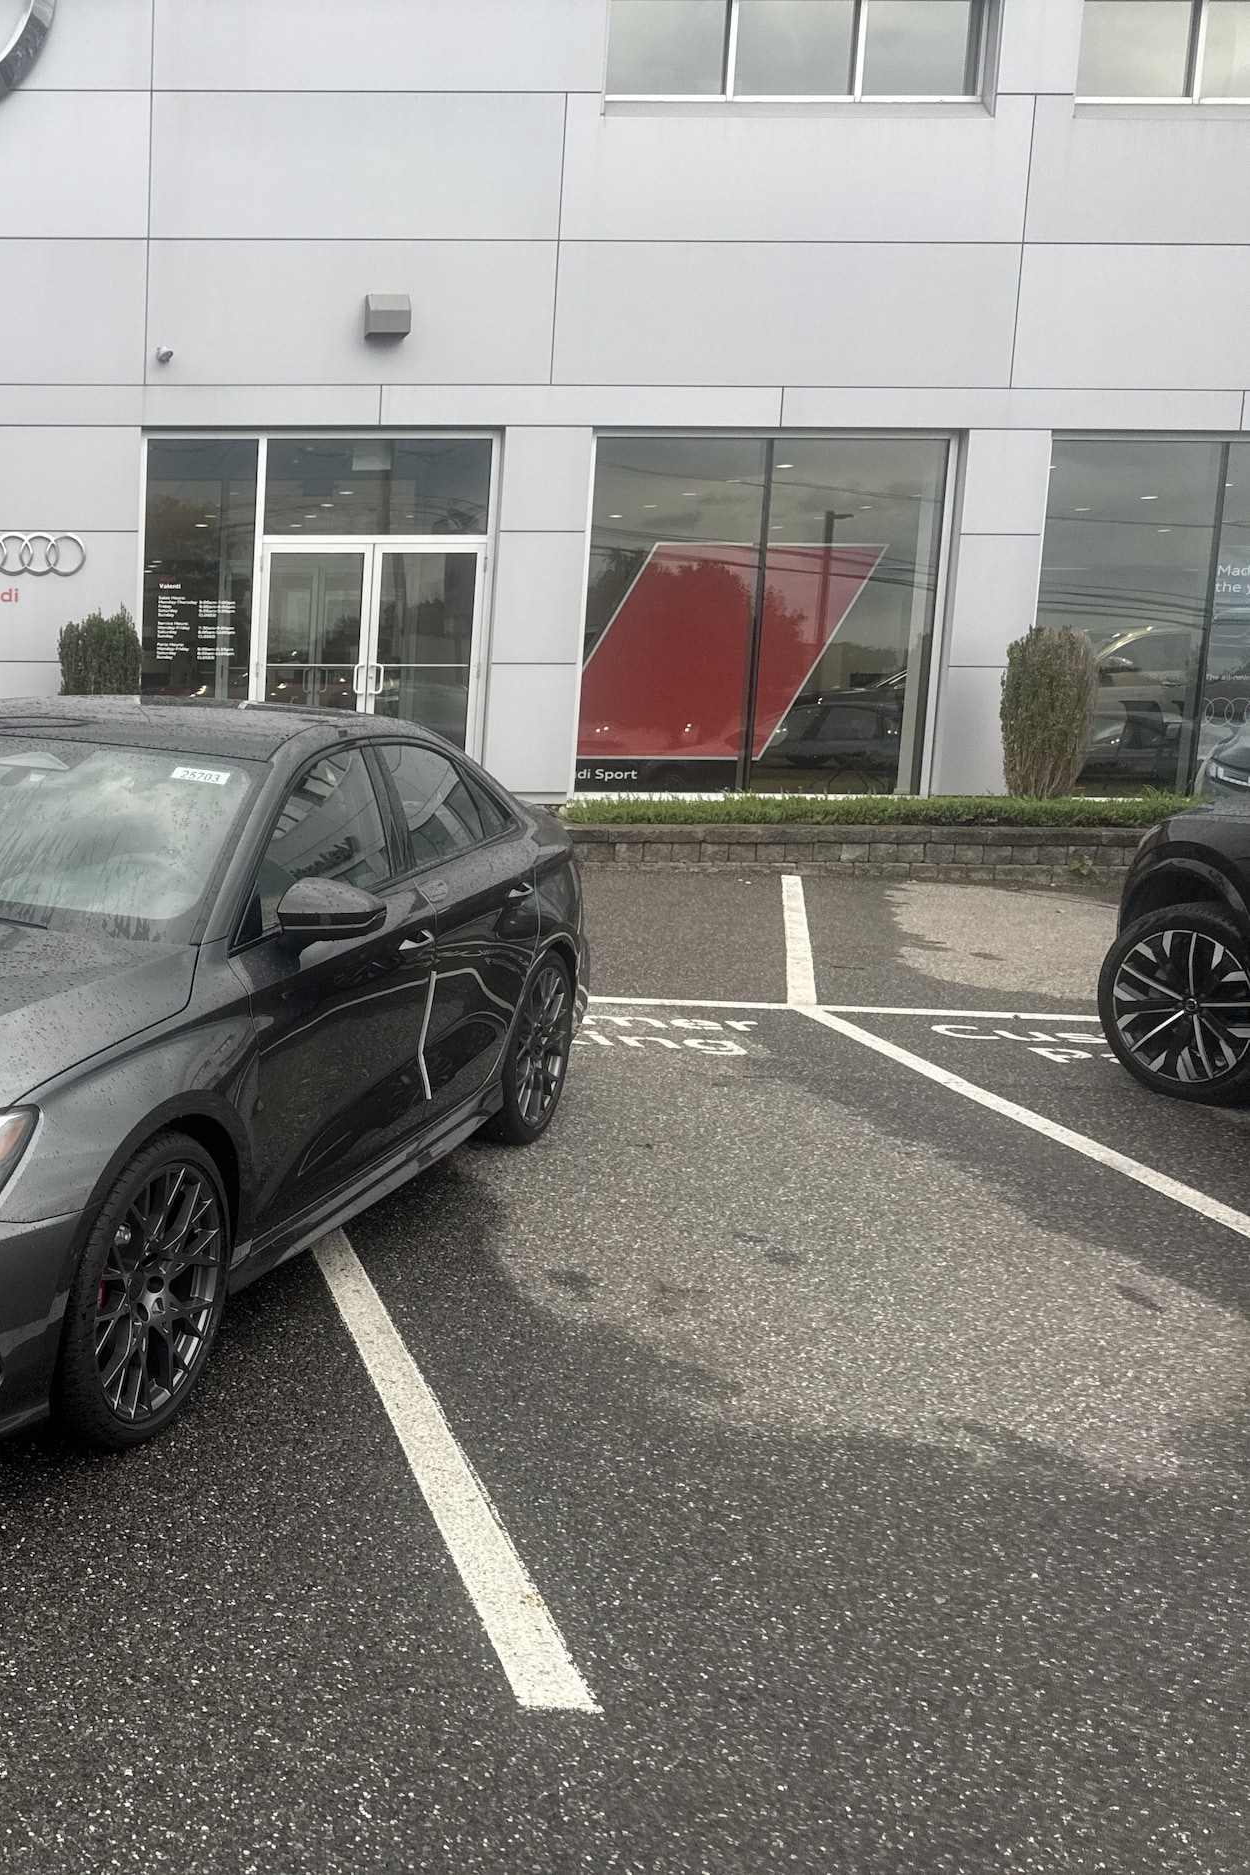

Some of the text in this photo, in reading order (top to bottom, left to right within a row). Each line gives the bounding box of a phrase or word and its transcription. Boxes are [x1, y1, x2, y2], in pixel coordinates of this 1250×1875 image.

[1215, 581, 1241, 593] the
[180, 770, 221, 783] 25703
[577, 768, 638, 782] di Sport
[572, 1030, 749, 1056] ing
